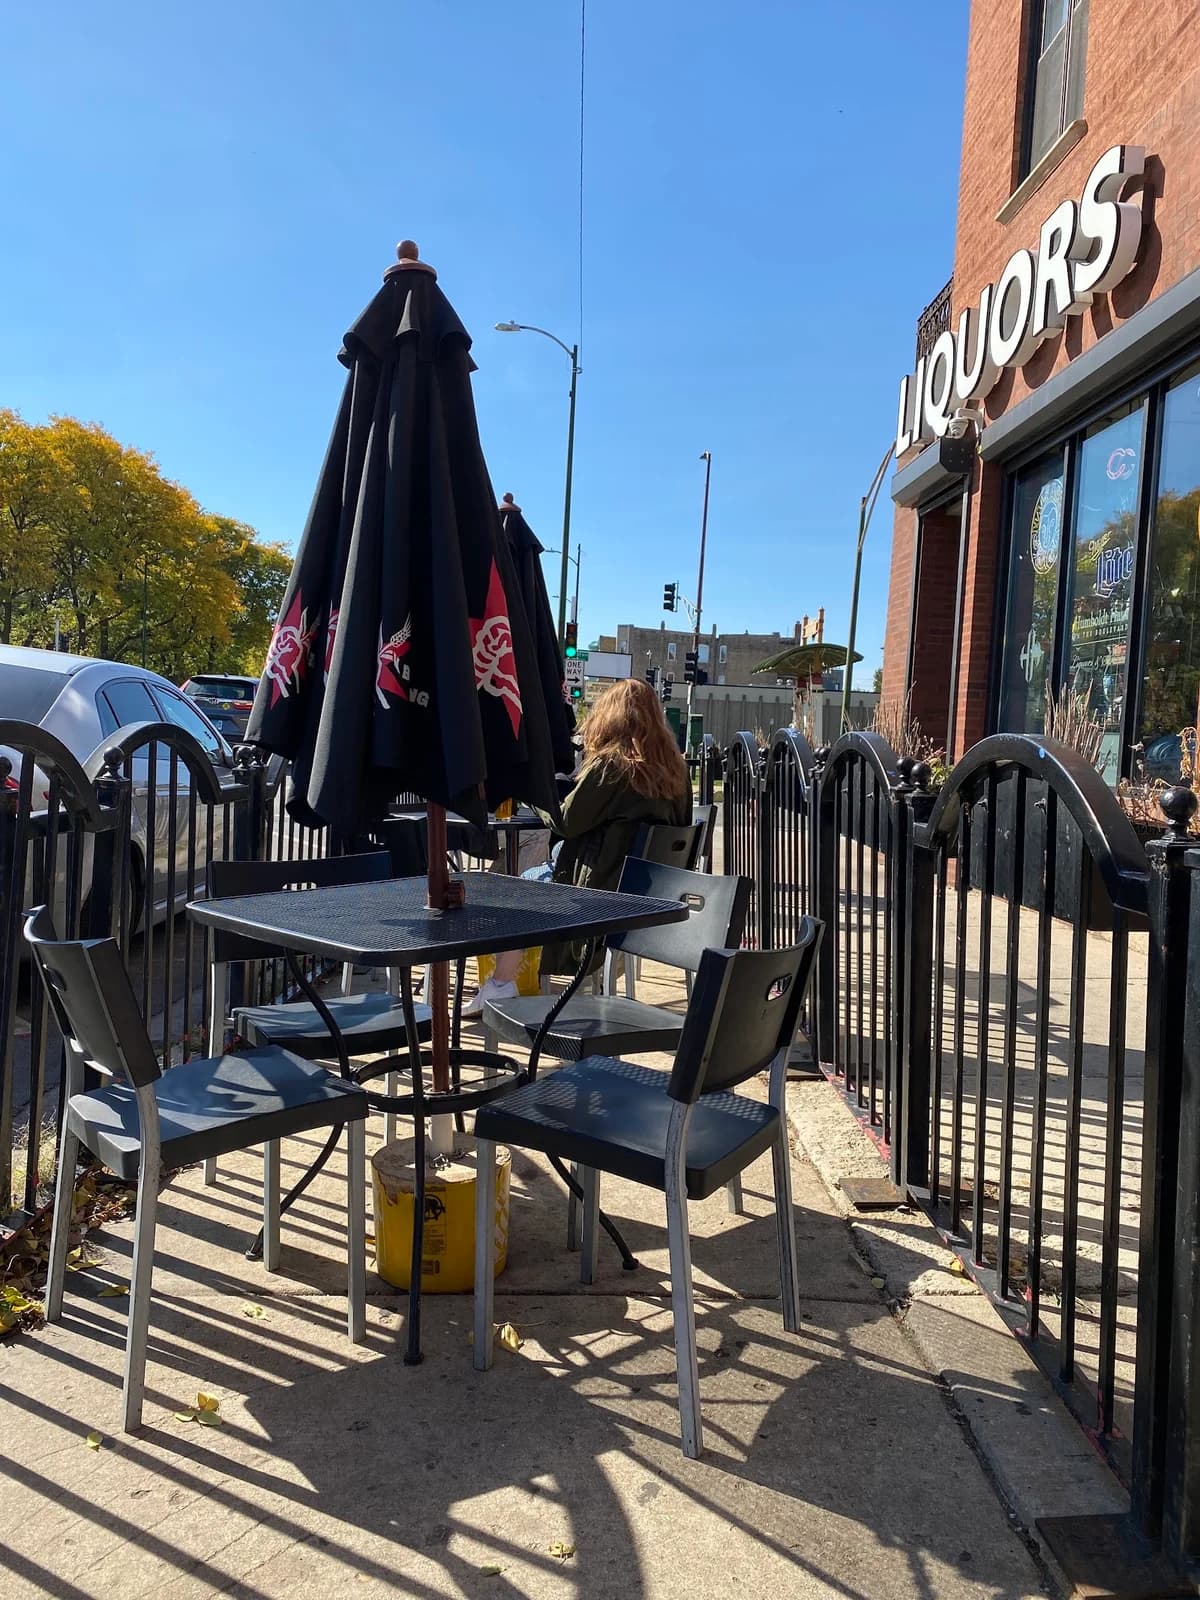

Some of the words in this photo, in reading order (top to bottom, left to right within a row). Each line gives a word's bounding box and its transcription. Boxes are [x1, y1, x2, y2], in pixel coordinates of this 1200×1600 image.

[896, 145, 1142, 458] LIQUORS
[1096, 546, 1134, 598] Lite
[1073, 608, 1109, 631] Humboldt
[1095, 623, 1128, 636] BOULEVARD
